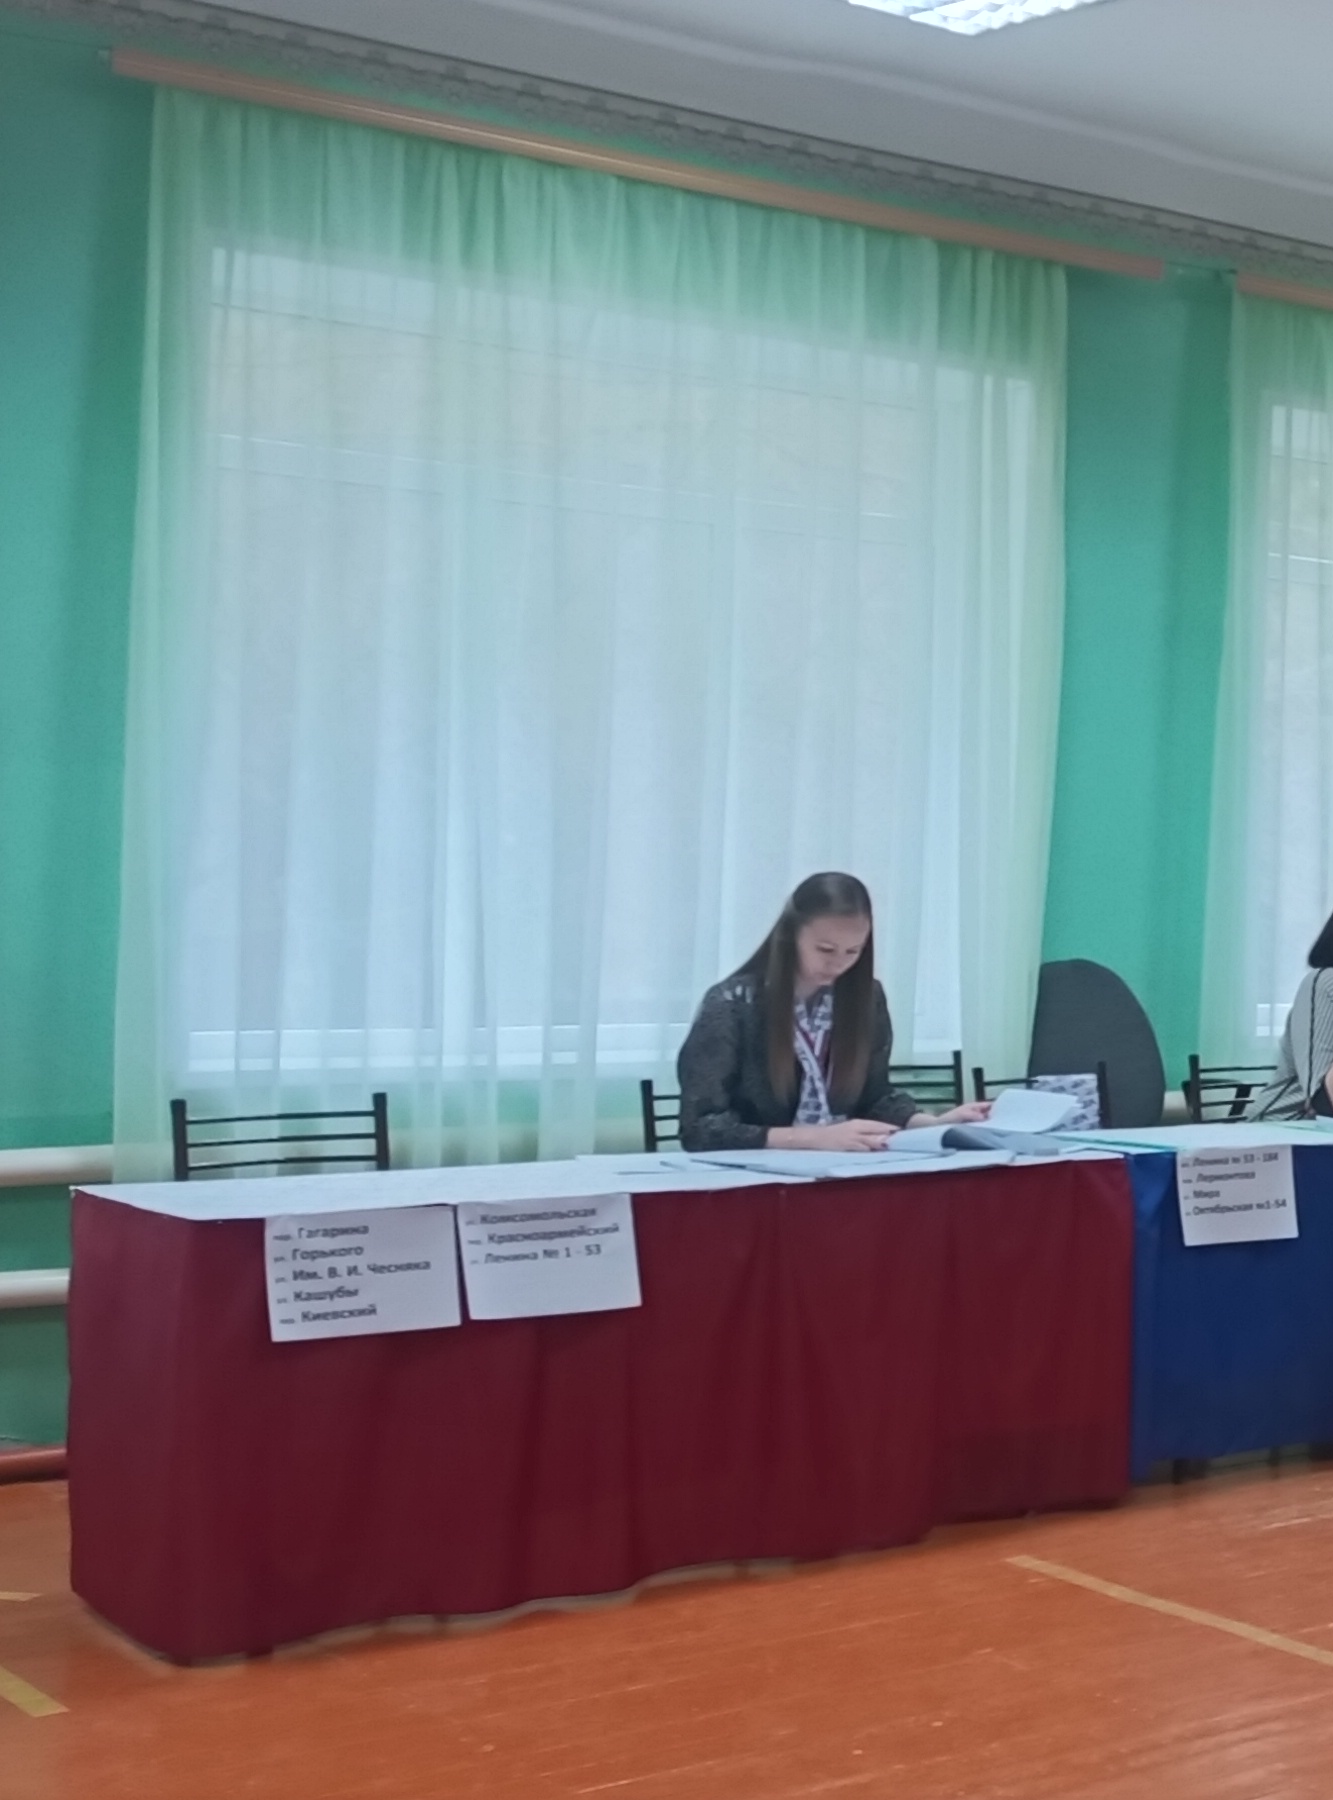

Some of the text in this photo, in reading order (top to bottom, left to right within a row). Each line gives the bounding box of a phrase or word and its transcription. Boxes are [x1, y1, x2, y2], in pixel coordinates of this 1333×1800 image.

[480, 1208, 597, 1225] Комсомольская
[298, 1225, 369, 1239] Гагарина
[488, 1223, 620, 1245] Красноармейский
[292, 1246, 364, 1261] Горького
[484, 1251, 538, 1264] Ленина
[585, 1244, 602, 1256] 53
[327, 1266, 342, 1278] В.
[347, 1265, 363, 1276] И.
[293, 1286, 359, 1302] Кашубы
[301, 1304, 377, 1322] Киевский
